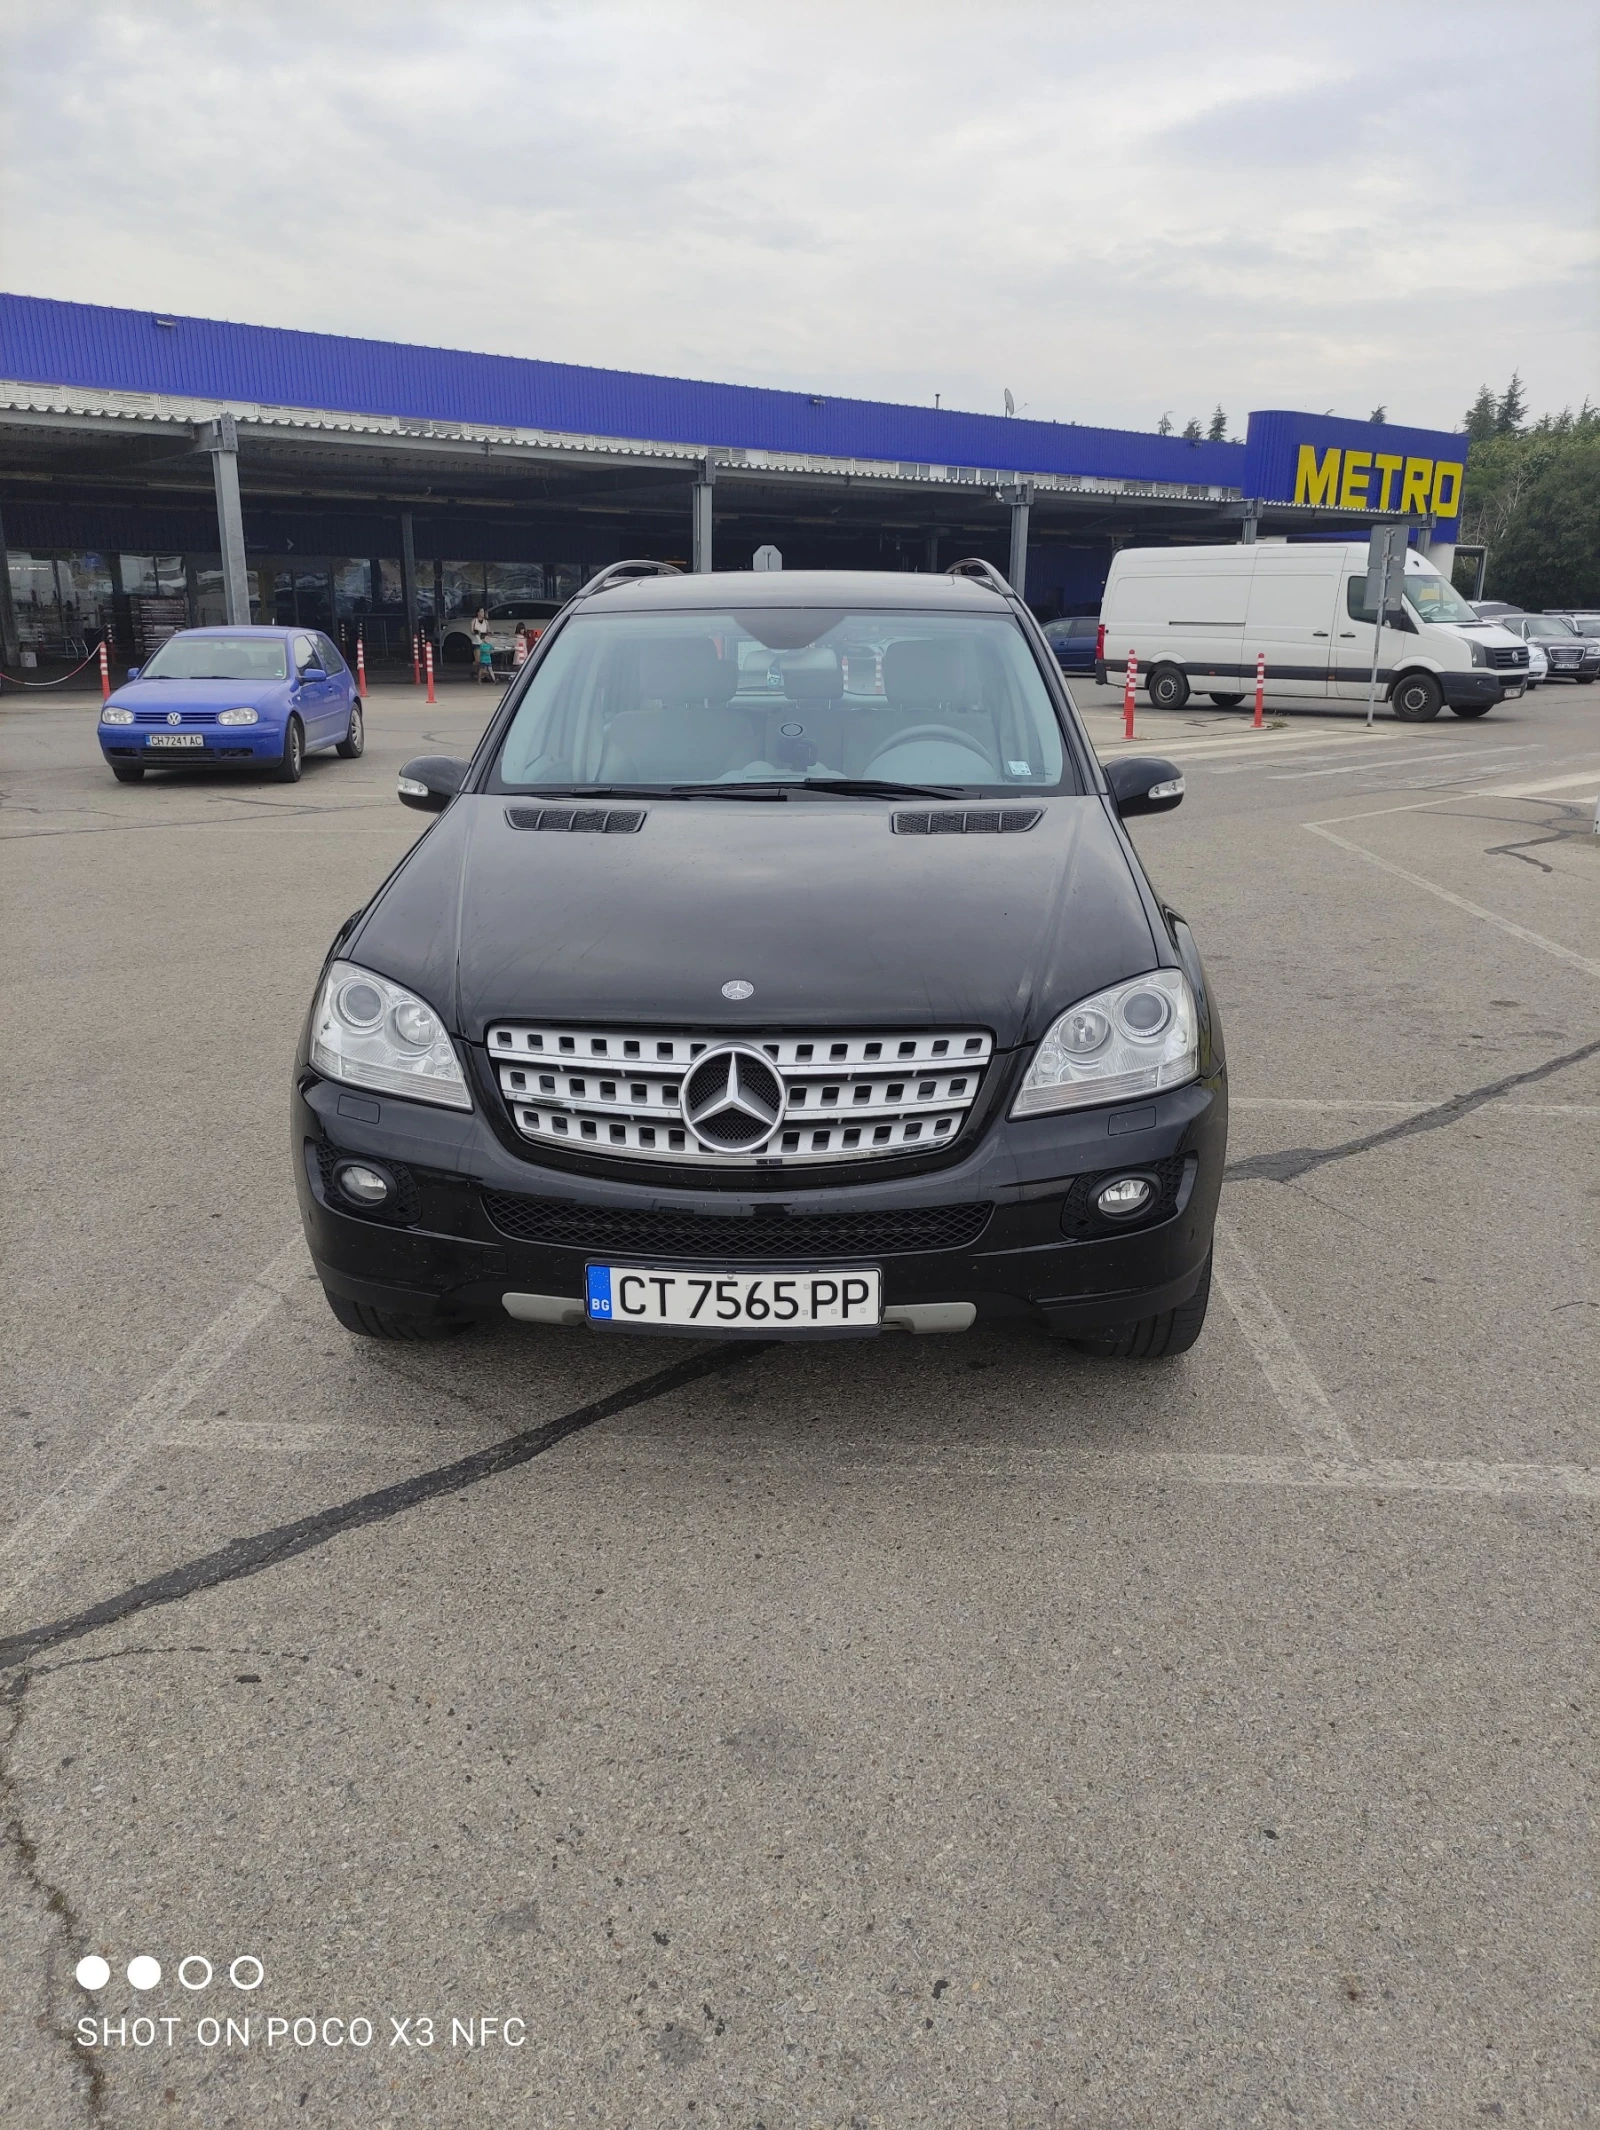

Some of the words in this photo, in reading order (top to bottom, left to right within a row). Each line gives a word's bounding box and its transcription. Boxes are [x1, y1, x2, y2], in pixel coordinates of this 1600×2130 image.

[1294, 444, 1464, 518] METRO
[591, 1298, 610, 1312] BG
[687, 1280, 799, 1320] 7565
[811, 1279, 869, 1319] PP
